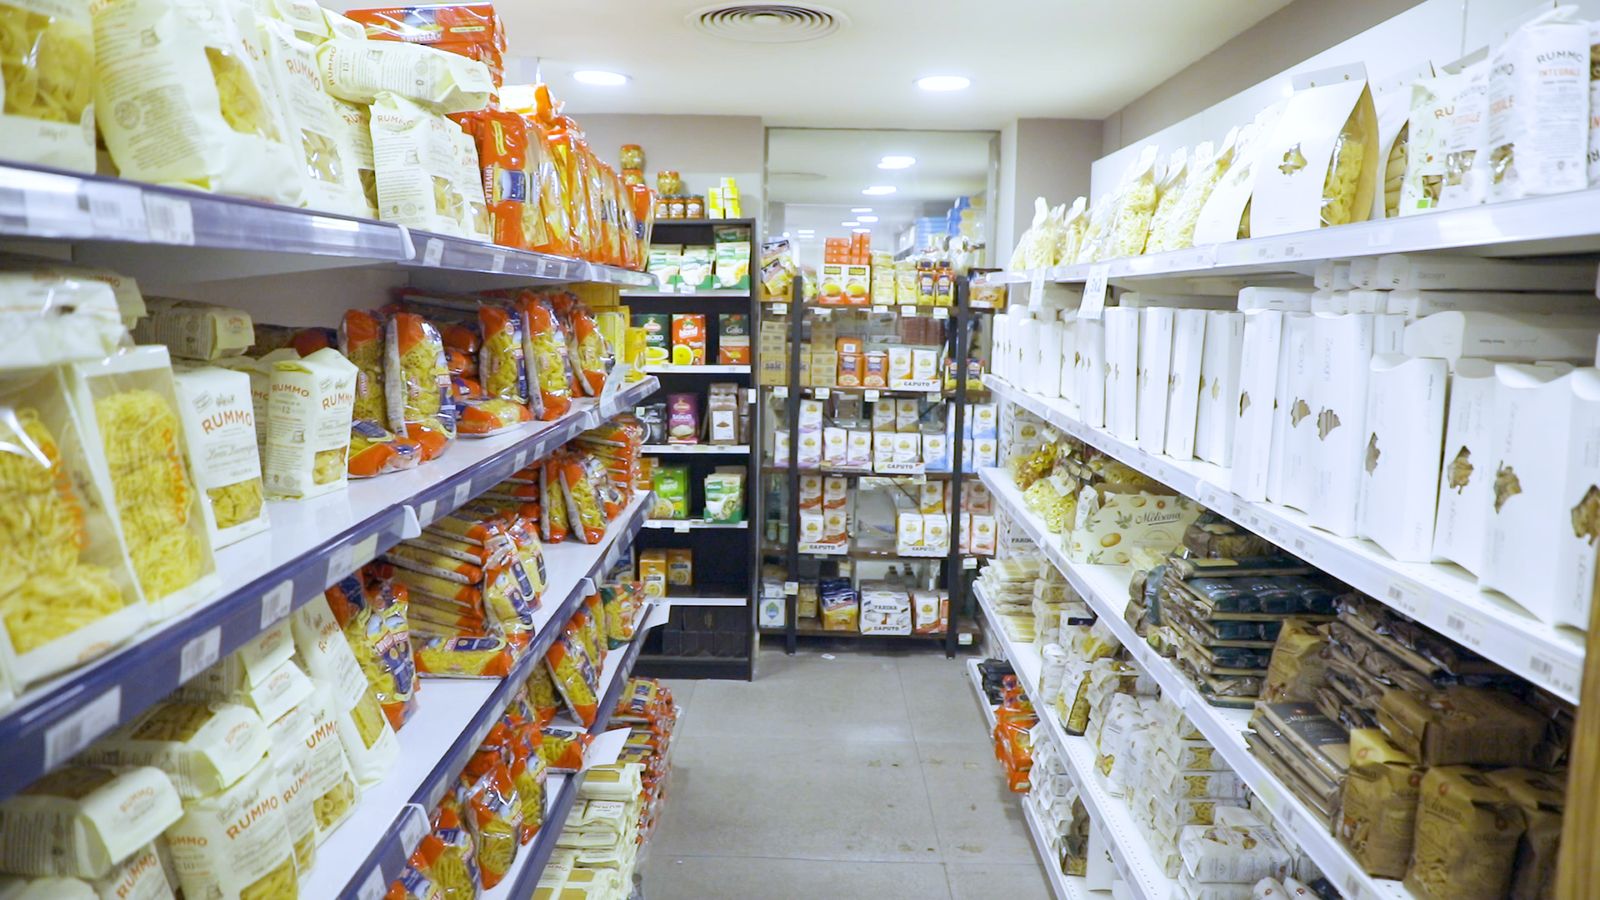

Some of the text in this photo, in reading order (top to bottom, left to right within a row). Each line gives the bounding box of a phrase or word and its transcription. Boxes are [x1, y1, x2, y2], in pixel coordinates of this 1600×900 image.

[1536, 49, 1584, 64] RUMMO
[285, 59, 320, 91] RUMMO
[484, 166, 494, 202] DIVELLA
[272, 384, 310, 398] RUMMO
[322, 393, 353, 410] RUMM
[202, 410, 253, 435] RUMMO
[318, 621, 342, 653] RMMO
[306, 720, 338, 749] UMM
[226, 795, 278, 840] RUMMO
[116, 853, 158, 899] RUMMO
